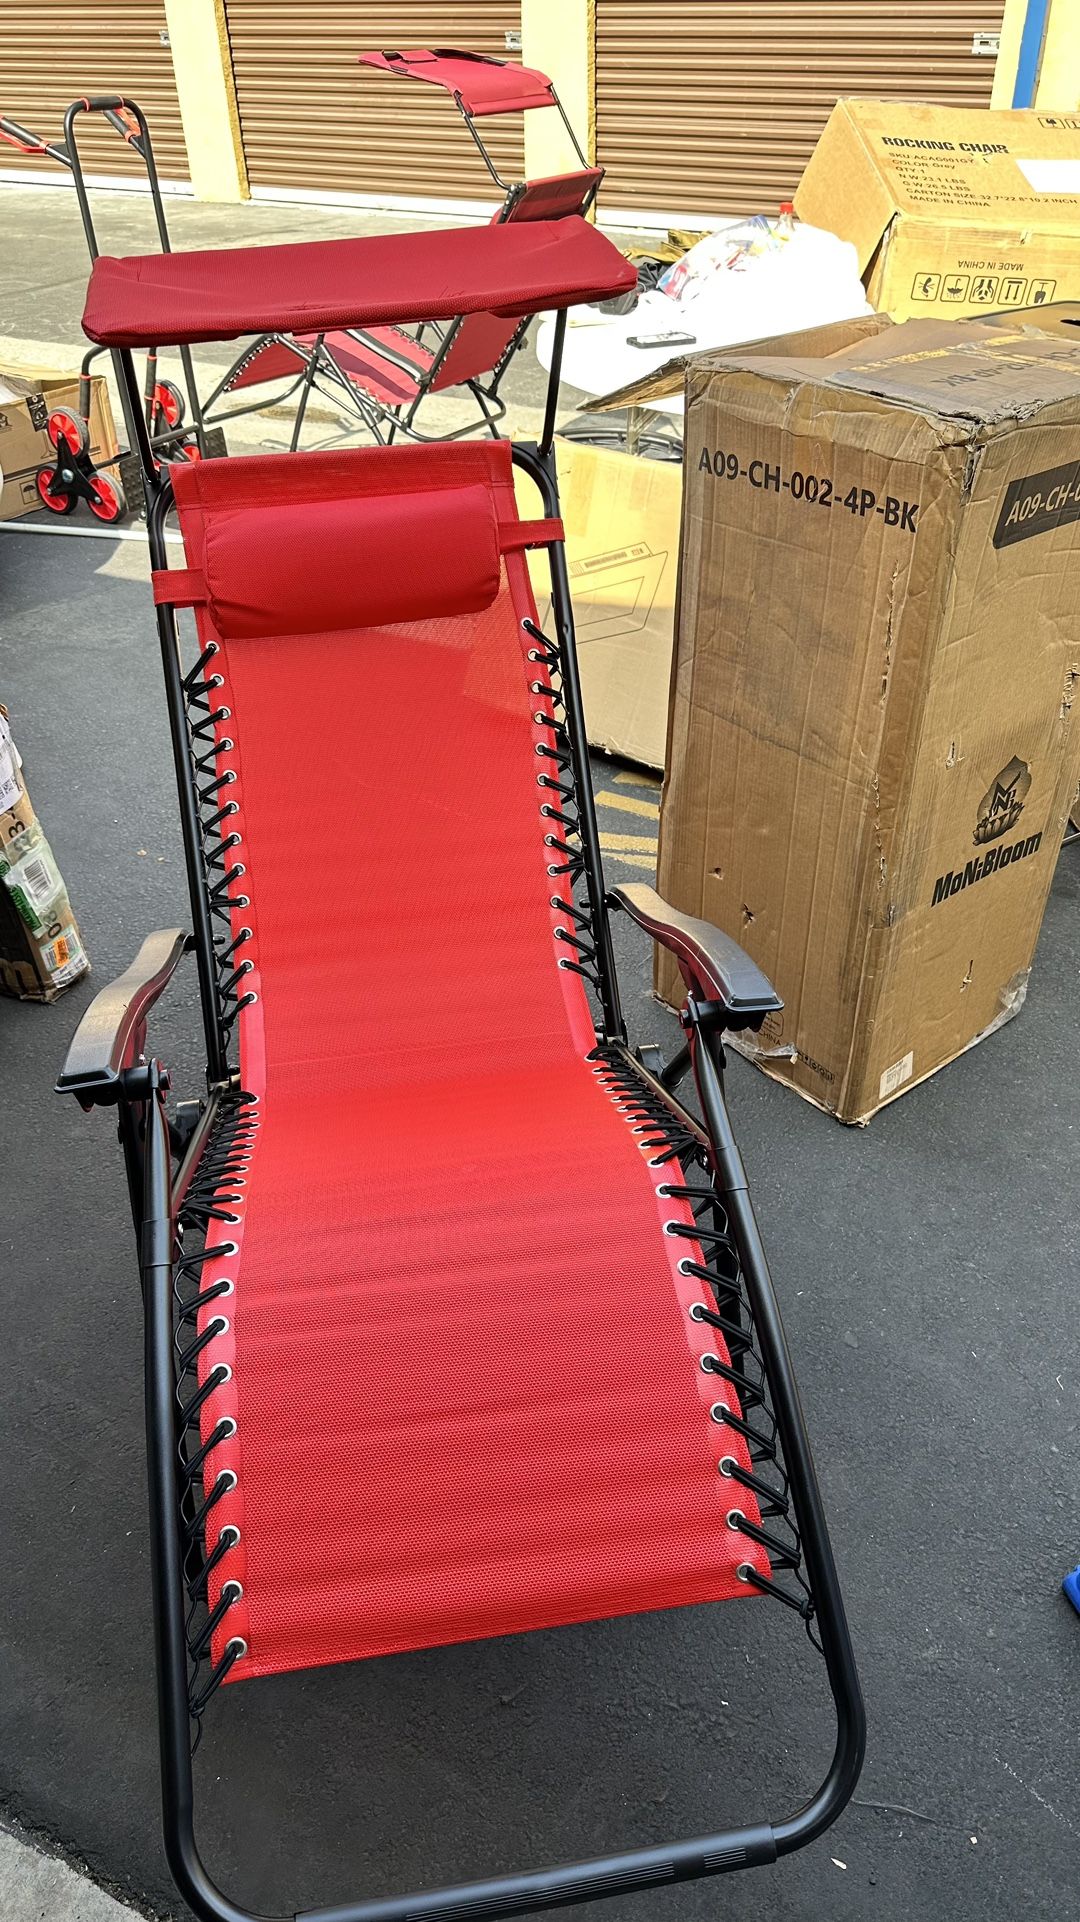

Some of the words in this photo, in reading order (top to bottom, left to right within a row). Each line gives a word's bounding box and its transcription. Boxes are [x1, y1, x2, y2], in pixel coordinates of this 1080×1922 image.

[881, 136, 955, 151] ROCKING
[959, 142, 1009, 154] CHAIR
[906, 188, 951, 197] CARTON
[909, 195, 941, 203] MADE
[958, 260, 985, 269] CHINA
[987, 261, 997, 269] IN
[998, 262, 1024, 271] MADE
[698, 447, 920, 533] A09-CH-002-4P-BK
[931, 831, 1042, 908] MoNiBloom
